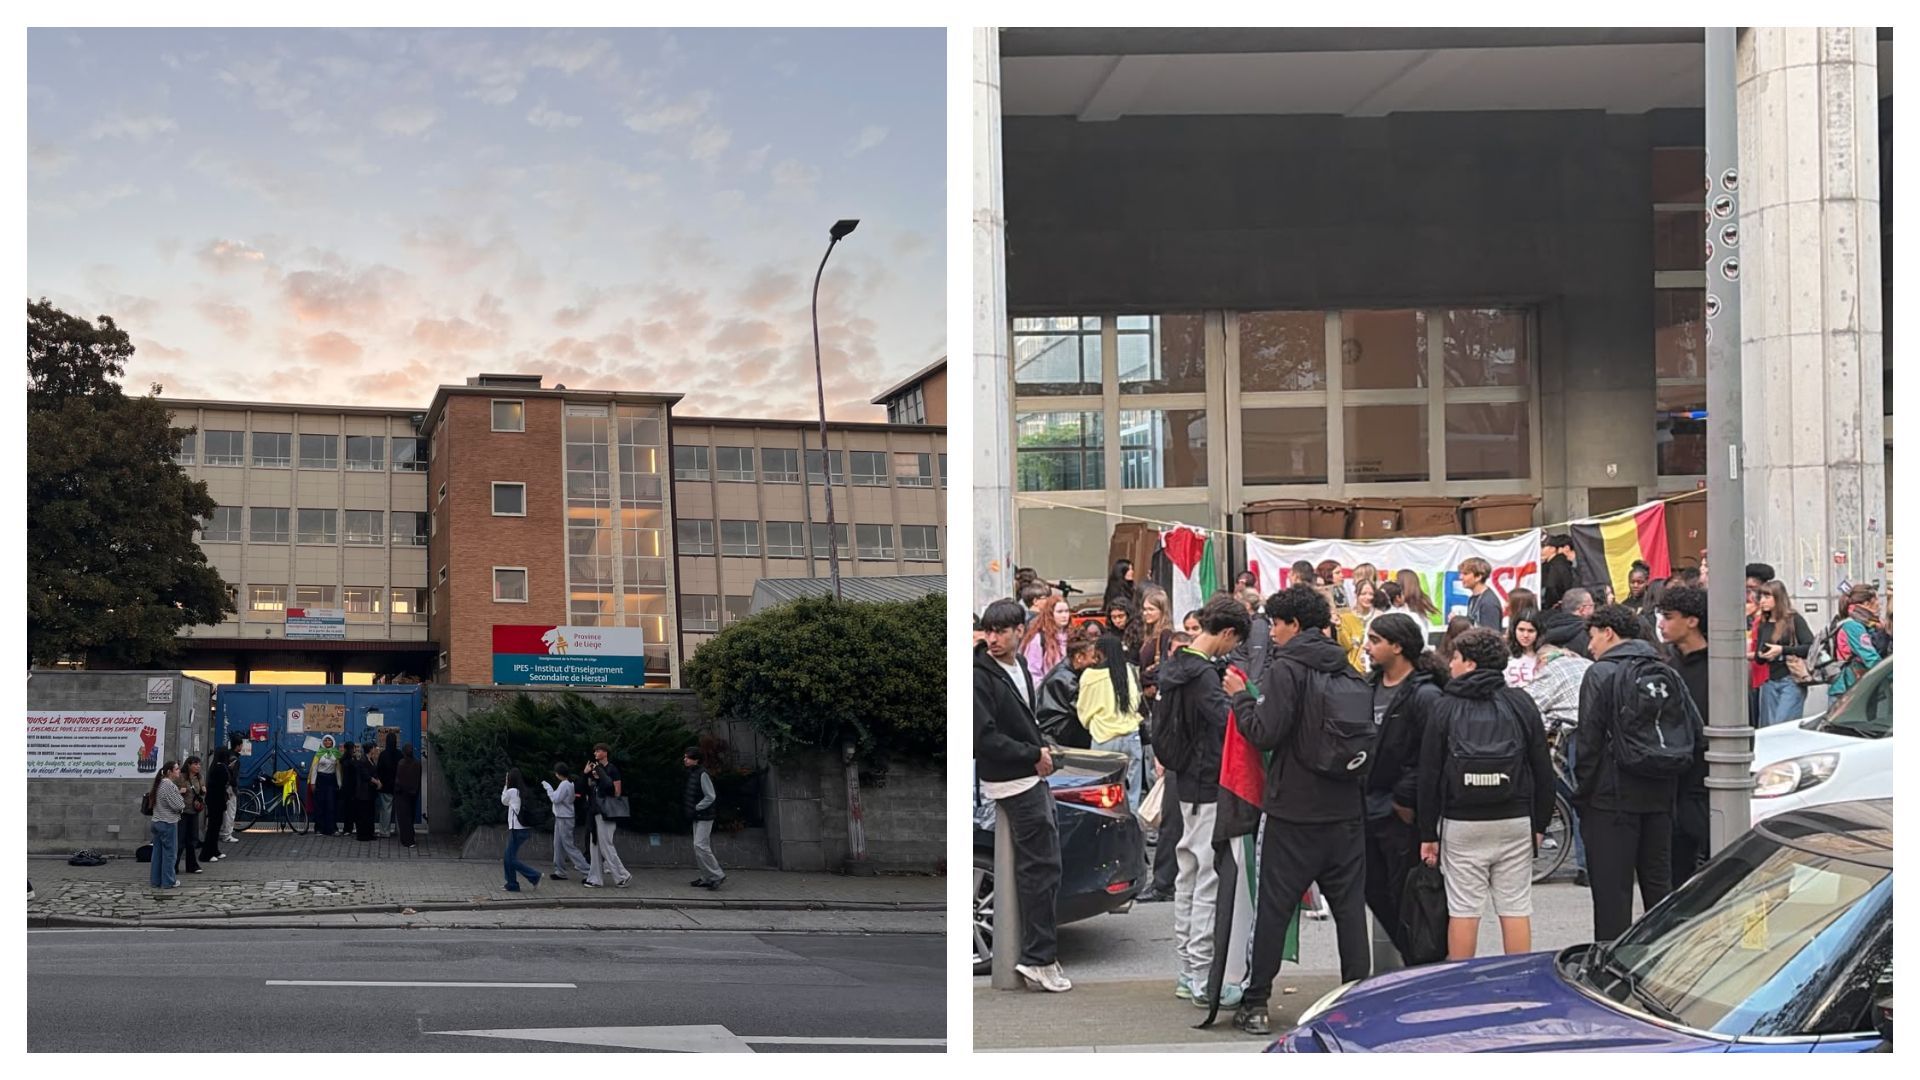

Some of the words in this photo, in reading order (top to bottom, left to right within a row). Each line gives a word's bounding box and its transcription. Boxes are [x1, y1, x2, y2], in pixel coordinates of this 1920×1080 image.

[583, 641, 602, 649] Liège
[513, 664, 529, 672] IPES
[534, 664, 562, 673] Institut
[564, 665, 623, 675] d'Enseignement
[530, 673, 570, 682] Secondaire
[571, 674, 580, 682] de
[581, 674, 608, 683] Herstal
[64, 717, 100, 725] TOUJOURS
[102, 717, 114, 725] EN
[1464, 773, 1501, 786] PUMA
